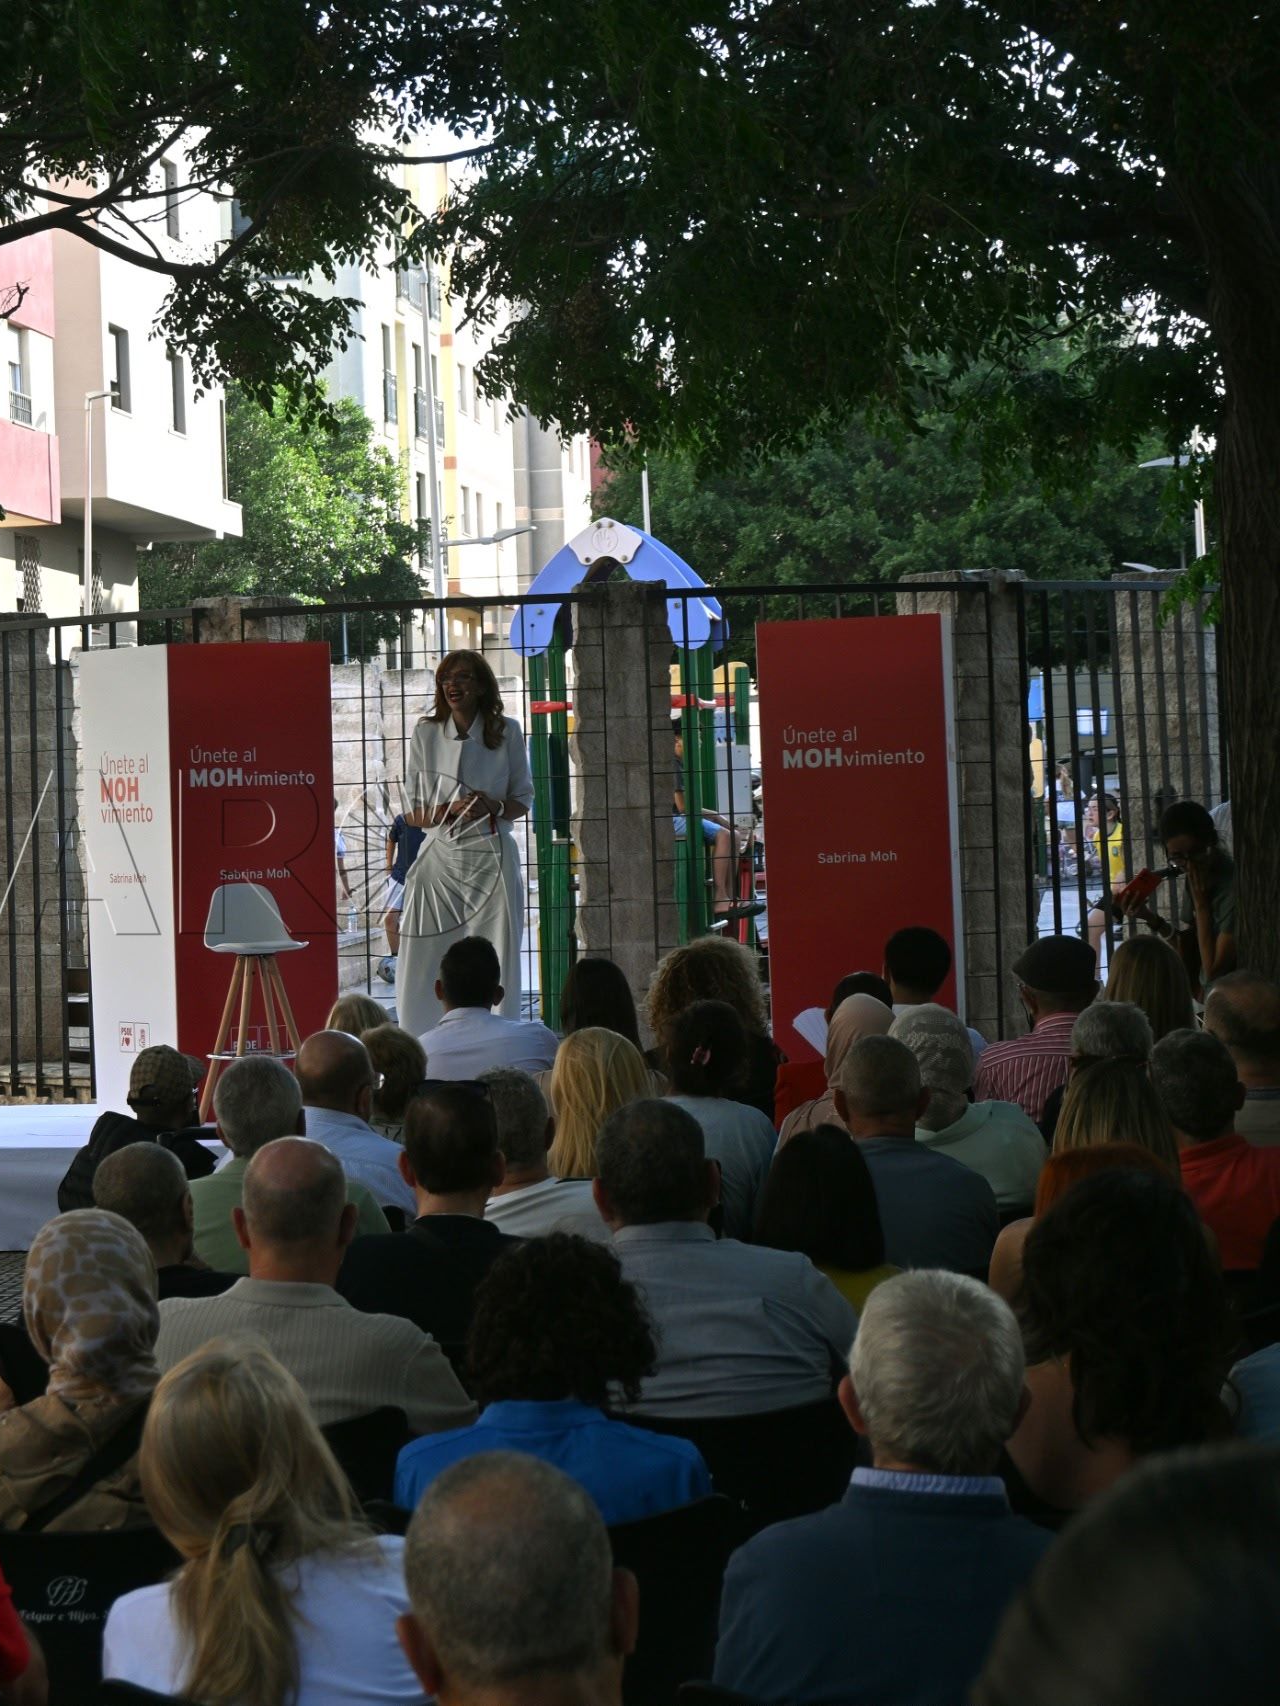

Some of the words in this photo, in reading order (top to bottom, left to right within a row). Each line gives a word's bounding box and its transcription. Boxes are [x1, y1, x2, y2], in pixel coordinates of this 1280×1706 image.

[783, 725, 837, 745] Únete
[842, 725, 857, 742] al
[100, 751, 135, 776] Únete
[138, 753, 149, 774] al
[190, 745, 238, 764] Únete
[243, 747, 257, 762] al
[782, 747, 926, 769] MOHvimiento
[189, 767, 315, 788] MOHvimiento
[100, 777, 139, 803] MOH
[101, 803, 153, 823] vimiento
[817, 852, 867, 864] Sabrina
[870, 850, 898, 862] Moh
[109, 873, 132, 884] Sabrina
[220, 868, 263, 880] Sabrina
[267, 867, 291, 878] Moh
